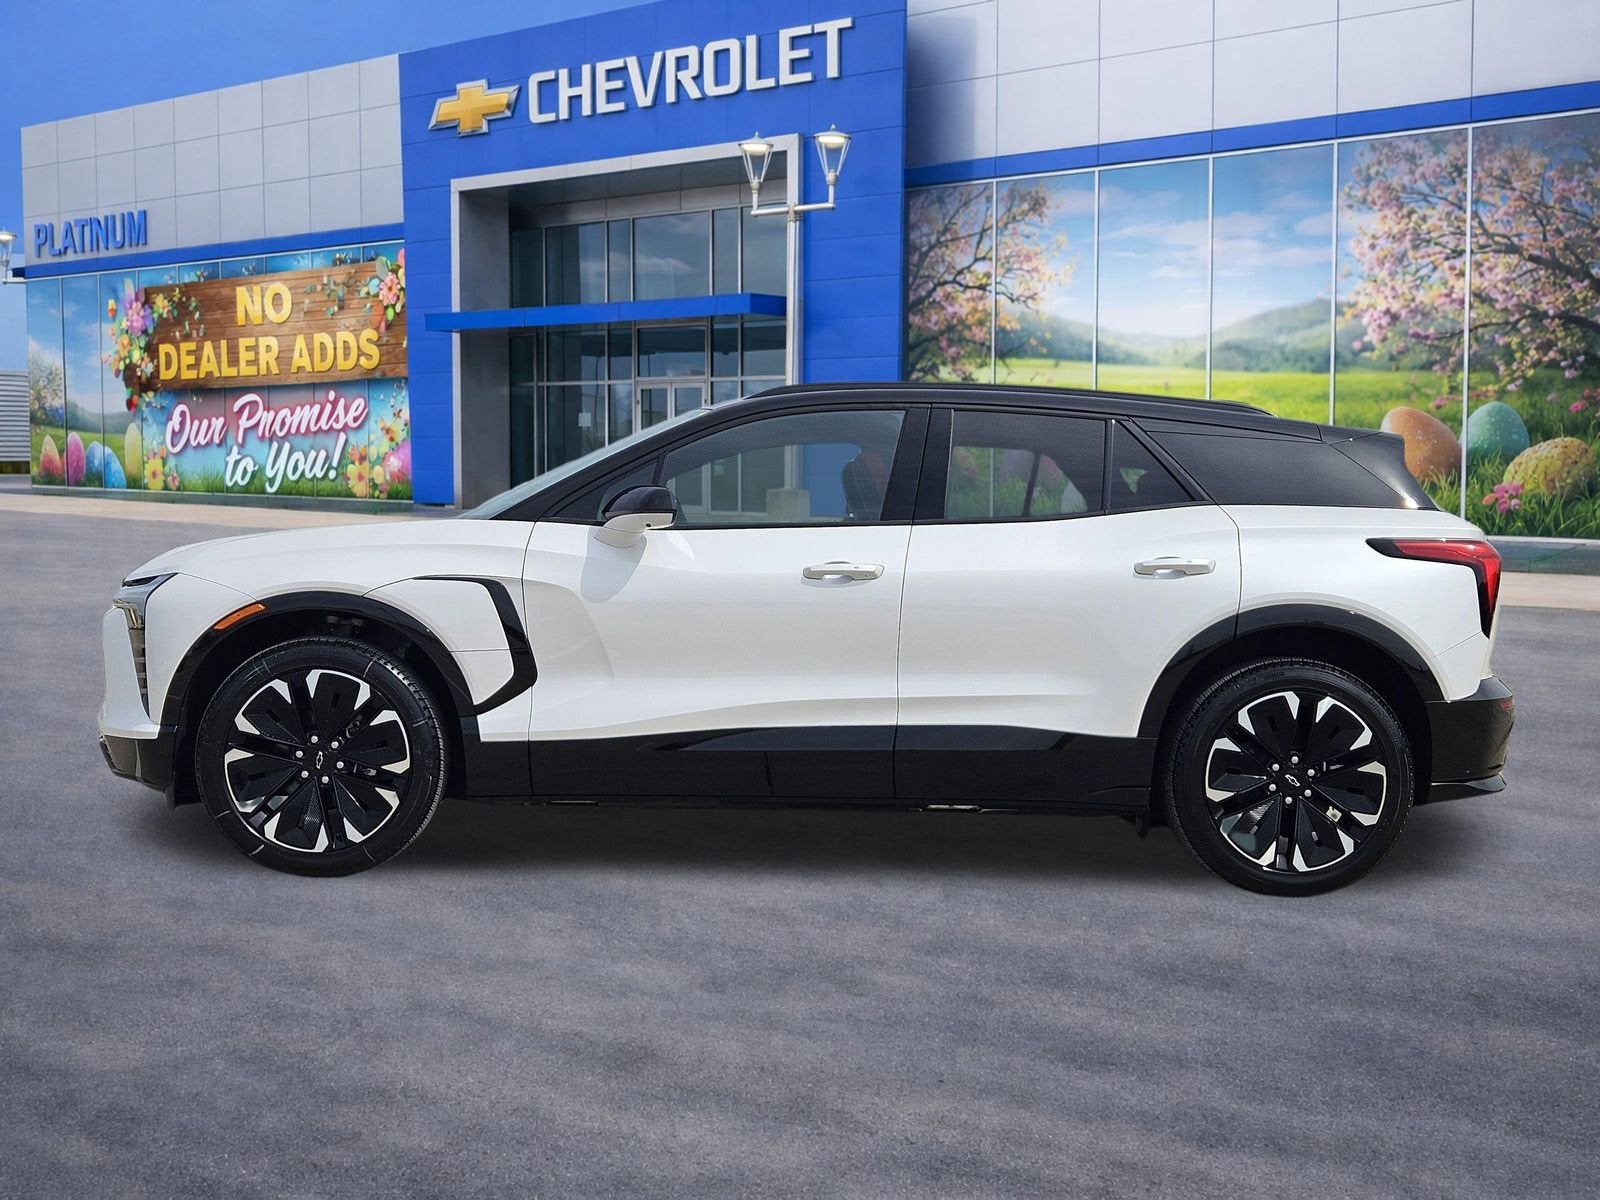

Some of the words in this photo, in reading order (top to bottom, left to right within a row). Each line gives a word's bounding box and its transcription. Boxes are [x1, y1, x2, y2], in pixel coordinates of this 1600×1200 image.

[528, 17, 854, 124] CHEVROLET
[33, 209, 148, 257] PLATINUM
[235, 282, 293, 326] NO
[158, 335, 279, 380] DEALER
[290, 328, 381, 373] ADDS
[164, 403, 228, 455] Our
[232, 390, 370, 443] Promise
[224, 446, 258, 488] to
[262, 433, 347, 494] You!
